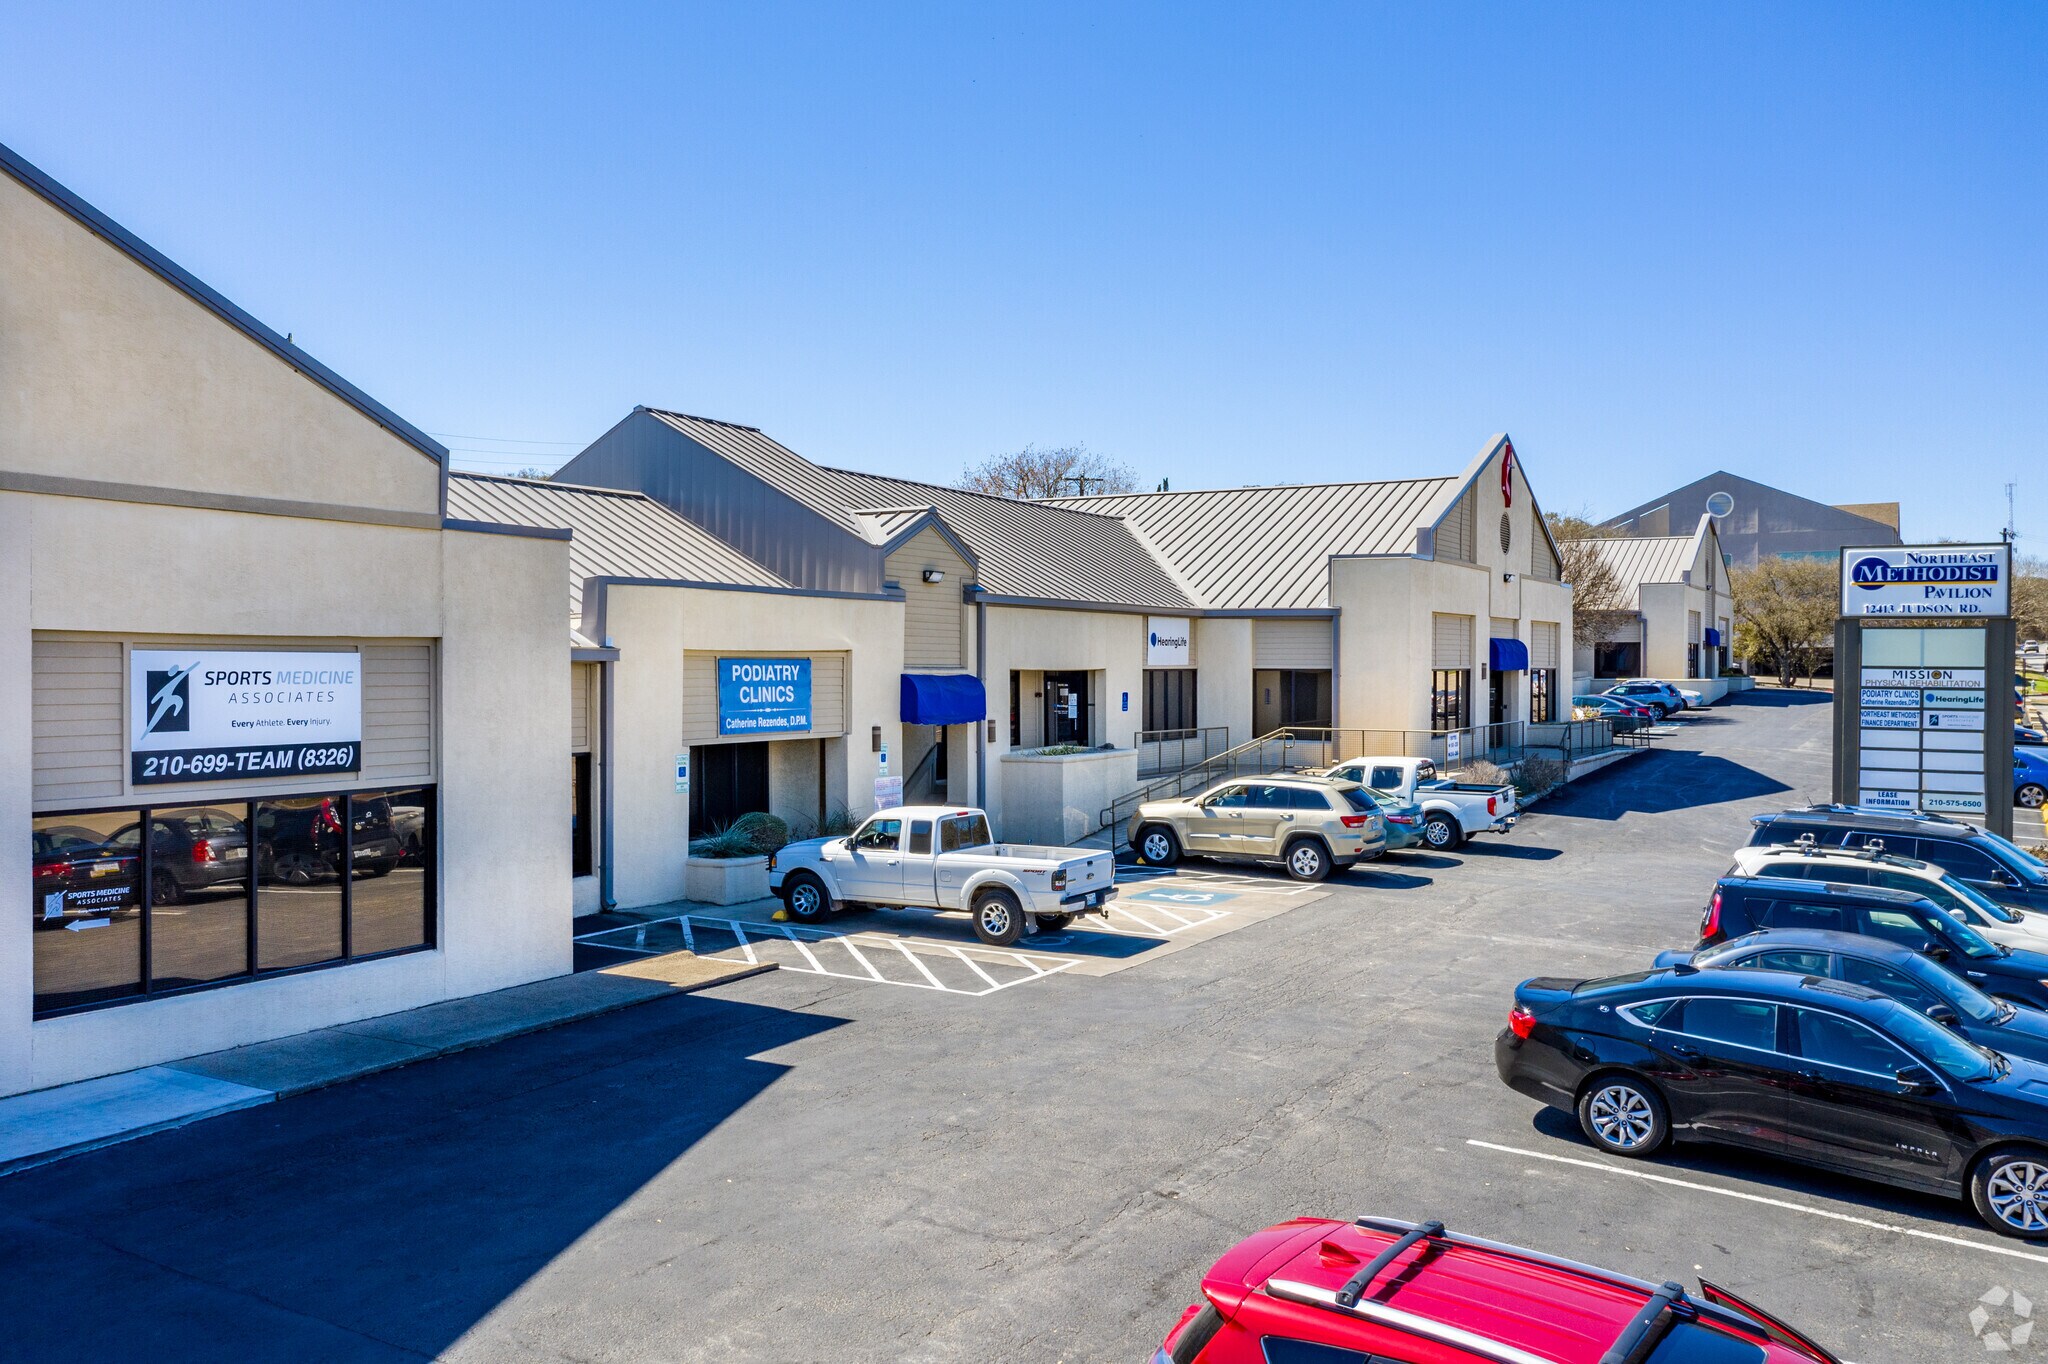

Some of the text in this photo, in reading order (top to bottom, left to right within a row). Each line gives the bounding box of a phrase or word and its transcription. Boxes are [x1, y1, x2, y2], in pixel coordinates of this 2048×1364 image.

[1906, 552, 1995, 564] NORTHEAST
[1859, 565, 1996, 582] METHODIST
[1924, 585, 1992, 599] PAVILION
[1864, 604, 1982, 614] 12413 JUDSON RD.
[1157, 636, 1187, 649] HearingLife
[204, 670, 354, 686] SPORTS MEDICINE
[732, 664, 800, 682] PODIATRY
[1892, 670, 1953, 680] MISSION
[1865, 679, 1981, 688] PHYSICAL REHABILITATION
[228, 690, 335, 704] ASSOCIATES
[739, 685, 795, 704] CLINICS
[1861, 689, 1919, 698] PODIATRY CLINICS
[1935, 695, 1984, 704] HearingLife
[1890, 711, 1920, 719] METHODIST
[231, 717, 332, 729] Every Athlete. Every Injury.
[725, 715, 808, 729] Catherine Rezendes, D.P.M.
[1861, 719, 1883, 727] FINANCE
[143, 745, 354, 777] 210-699-TEAM (8326)
[1866, 798, 1910, 806] INFORMATION
[1929, 798, 1982, 808] 210-575-6500
[68, 887, 130, 900] SPORTS MEDICINE
[76, 895, 122, 906] ASSOCIATES
[1895, 1143, 1938, 1157] IMPALA
